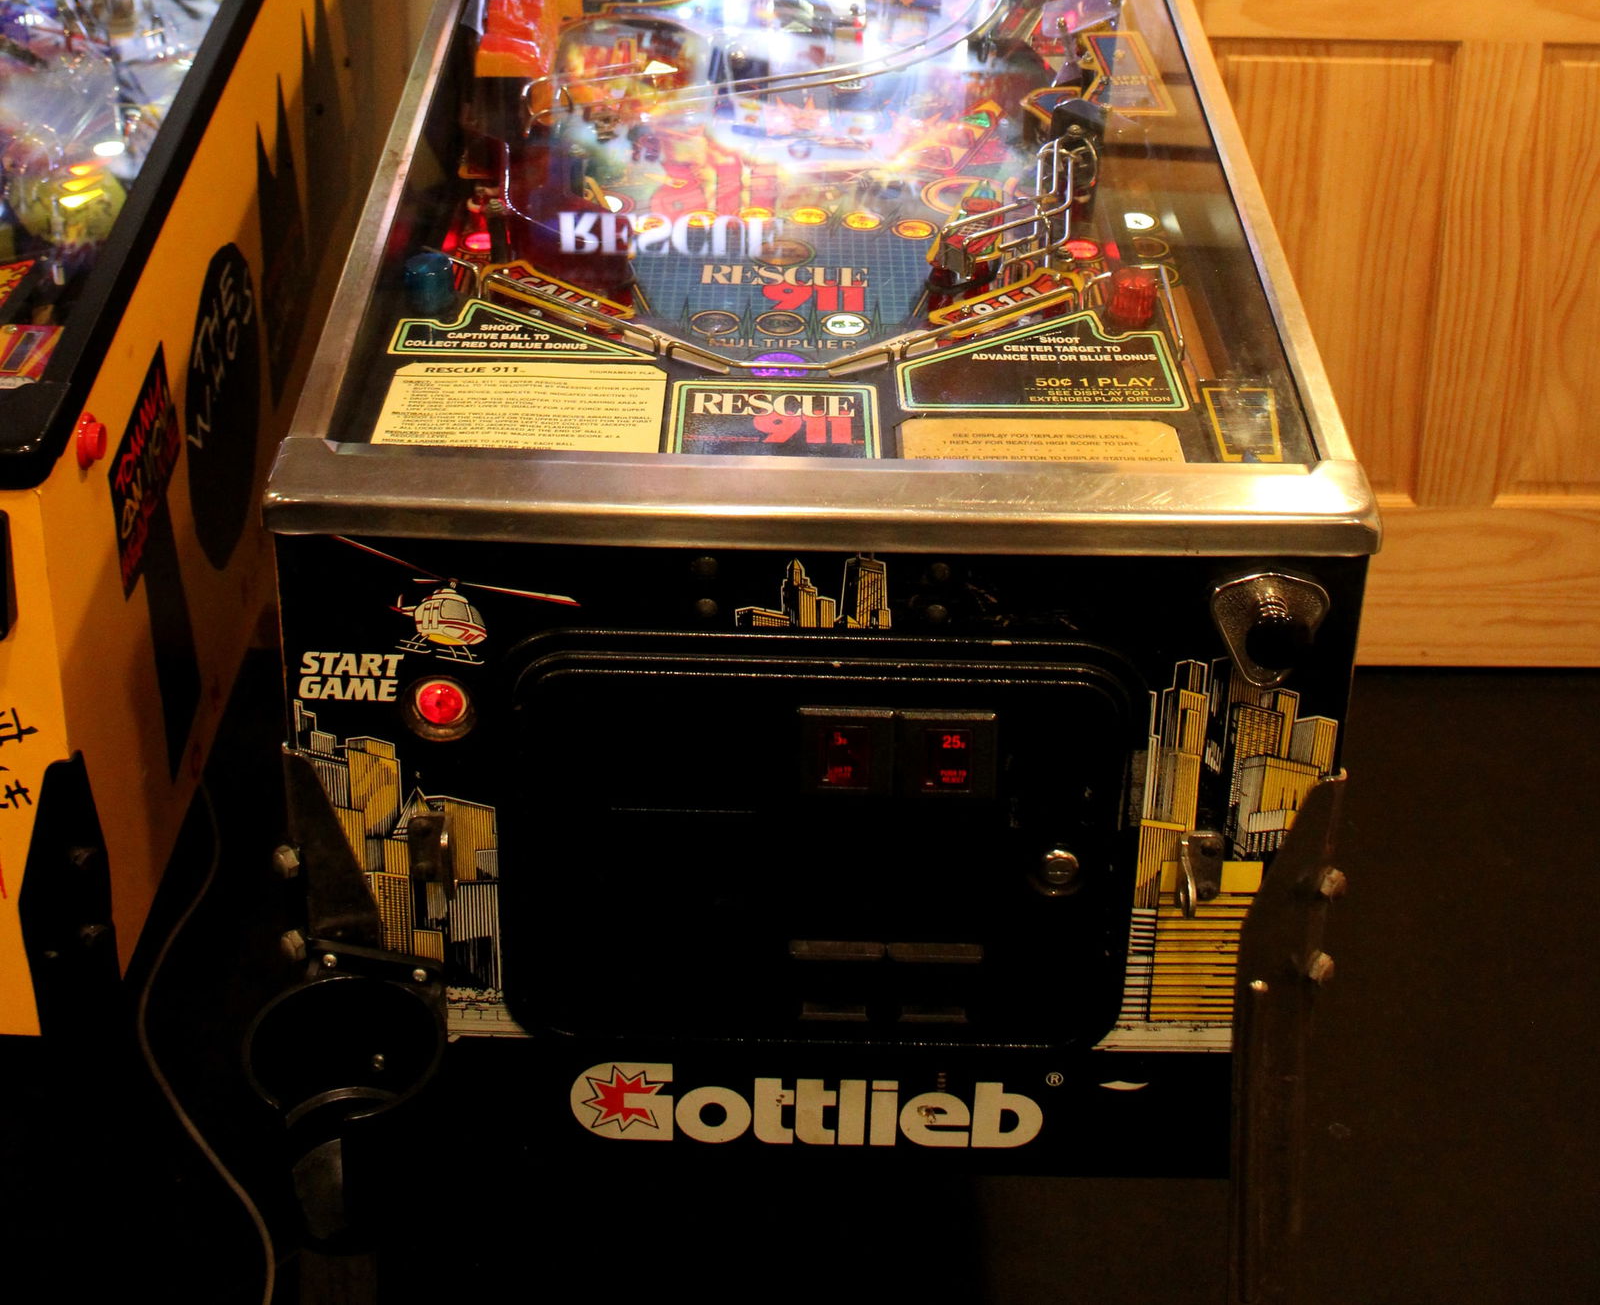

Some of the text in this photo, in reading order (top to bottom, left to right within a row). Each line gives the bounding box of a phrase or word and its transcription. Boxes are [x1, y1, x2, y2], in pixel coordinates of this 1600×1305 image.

[701, 264, 868, 287] RESCUE
[762, 280, 865, 312] 911
[479, 324, 523, 332] SHOOT
[446, 332, 550, 341] CAPTIVE BALL TO
[1039, 336, 1081, 344] SHOOT
[404, 339, 588, 351] COLLECT RED OR BLUE BONUS
[707, 337, 858, 350] MULTIPLIER
[1003, 344, 1121, 353] CENTER TARGET TO
[971, 353, 1029, 361] ADVANCE
[1059, 354, 1078, 362] OR
[1115, 353, 1157, 361] BONUS
[424, 366, 520, 374] RESCUE 911
[1035, 377, 1155, 388] 50¢ 1 PLAY
[691, 392, 856, 418] RESCUE
[753, 414, 853, 444] 911
[301, 651, 405, 677] START
[299, 678, 399, 702] GAME
[570, 1061, 1043, 1148] Gottlieb
